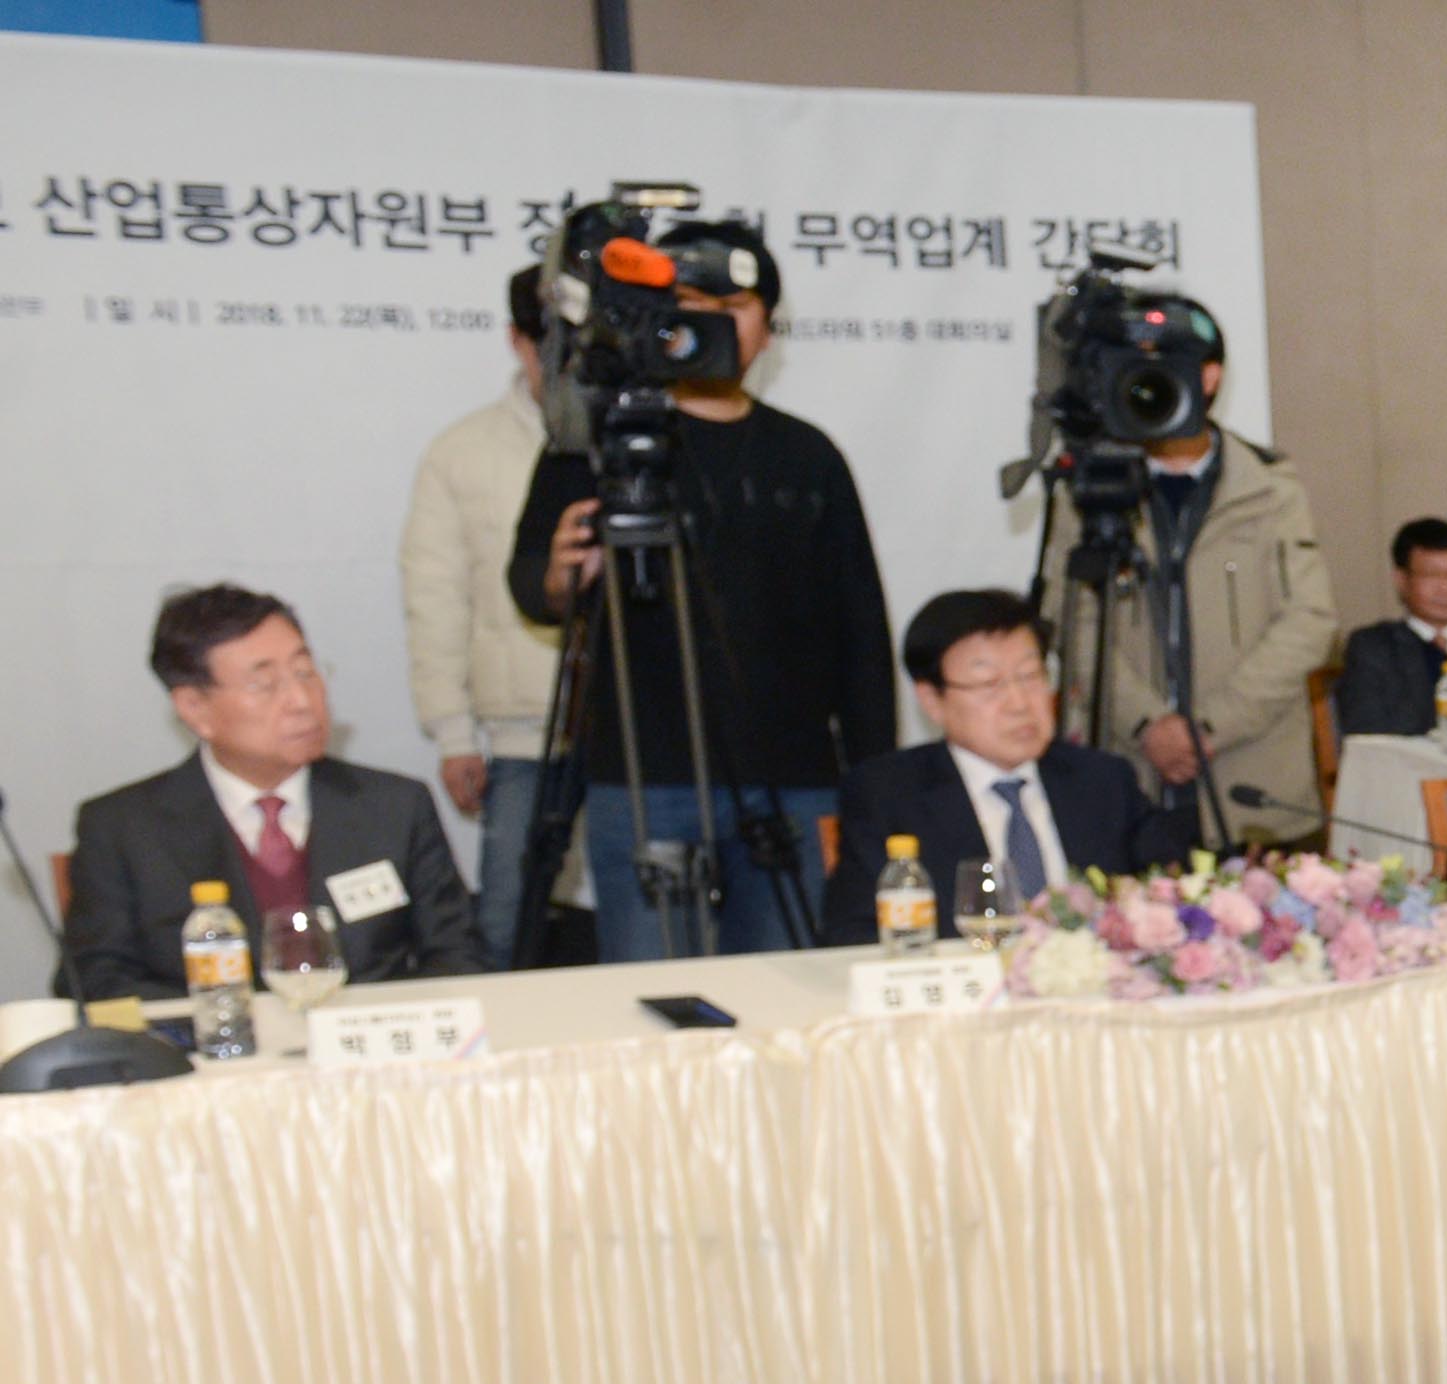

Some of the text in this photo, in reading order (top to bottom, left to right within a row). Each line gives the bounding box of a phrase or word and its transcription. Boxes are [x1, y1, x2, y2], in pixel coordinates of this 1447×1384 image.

[37, 176, 495, 257] 산업통상자원부
[792, 210, 1008, 269] 무역업계
[428, 307, 494, 331] 12:00
